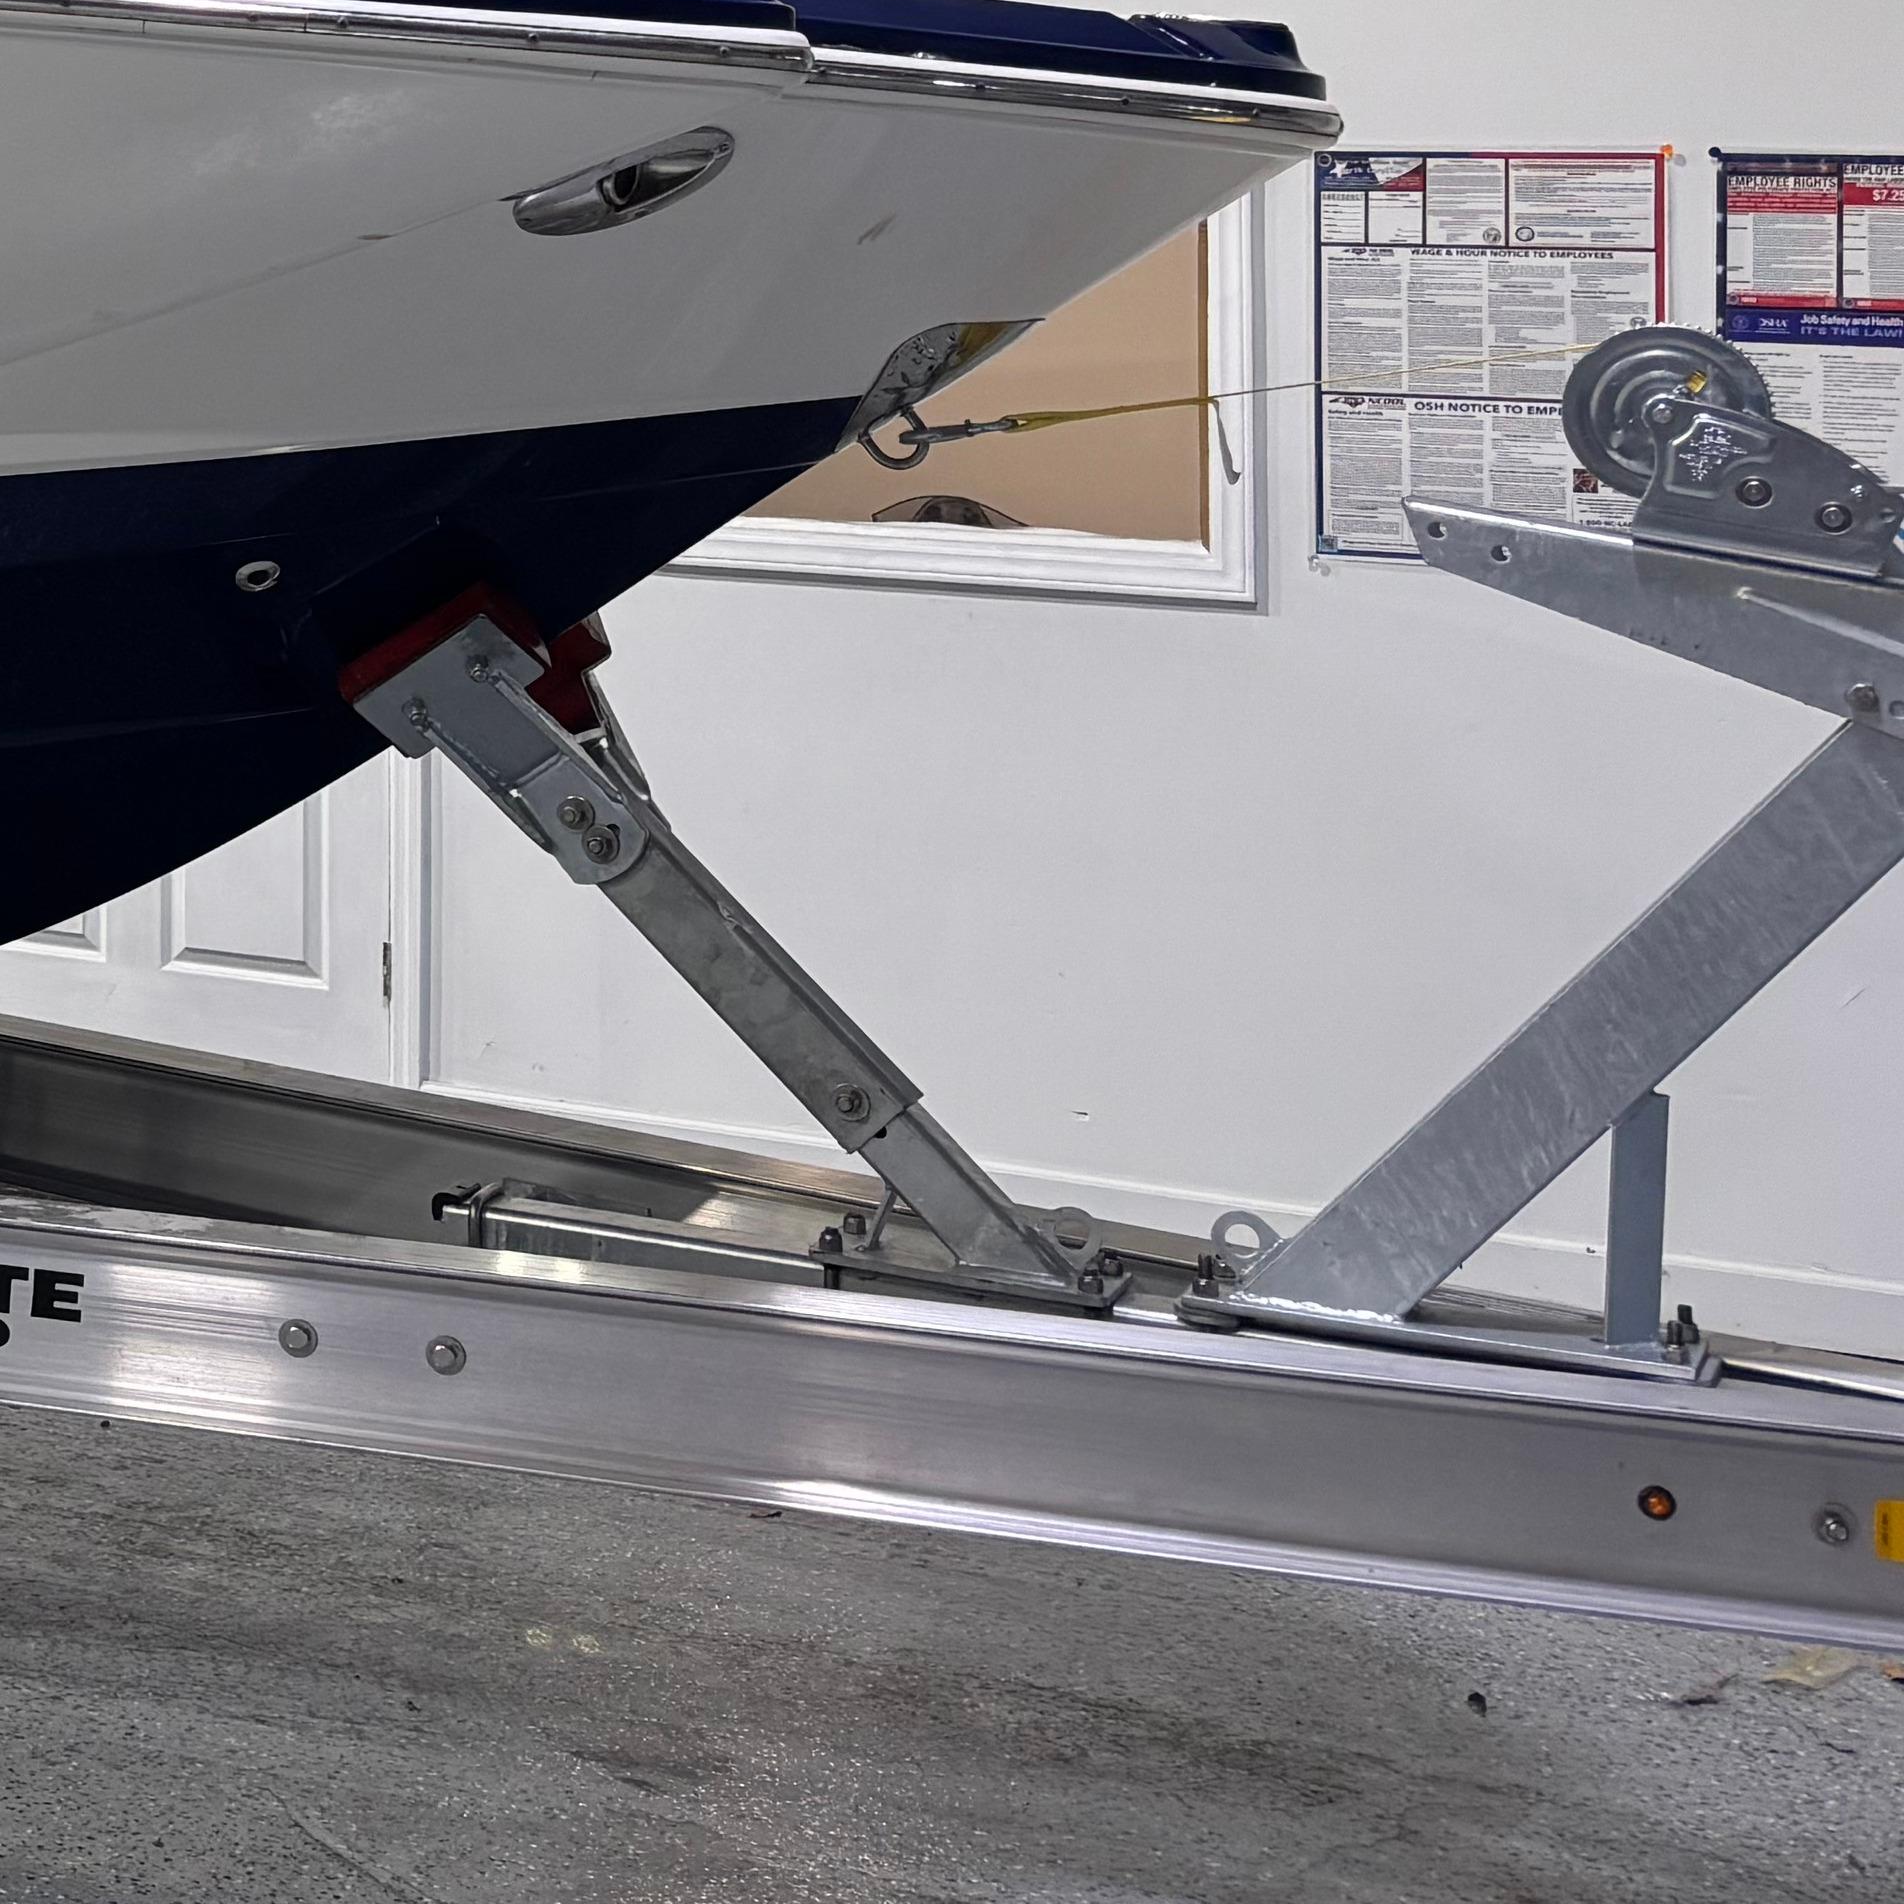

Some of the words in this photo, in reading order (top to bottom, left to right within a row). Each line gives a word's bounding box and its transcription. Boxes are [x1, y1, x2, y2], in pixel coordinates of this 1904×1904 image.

[1728, 176, 1790, 187] EMPLOYEE
[1793, 177, 1837, 188] RIGHTS
[1490, 250, 1530, 258] NOTICE
[1533, 251, 1548, 259] TO
[1800, 314, 1819, 325] Job
[1820, 315, 1850, 327] Safety
[1852, 316, 1870, 326] and
[1872, 316, 1904, 327] Health
[1830, 327, 1860, 336] THE
[1414, 401, 1444, 412] OSH
[1448, 402, 1500, 414] NOTICE
[1503, 404, 1523, 415] TO
